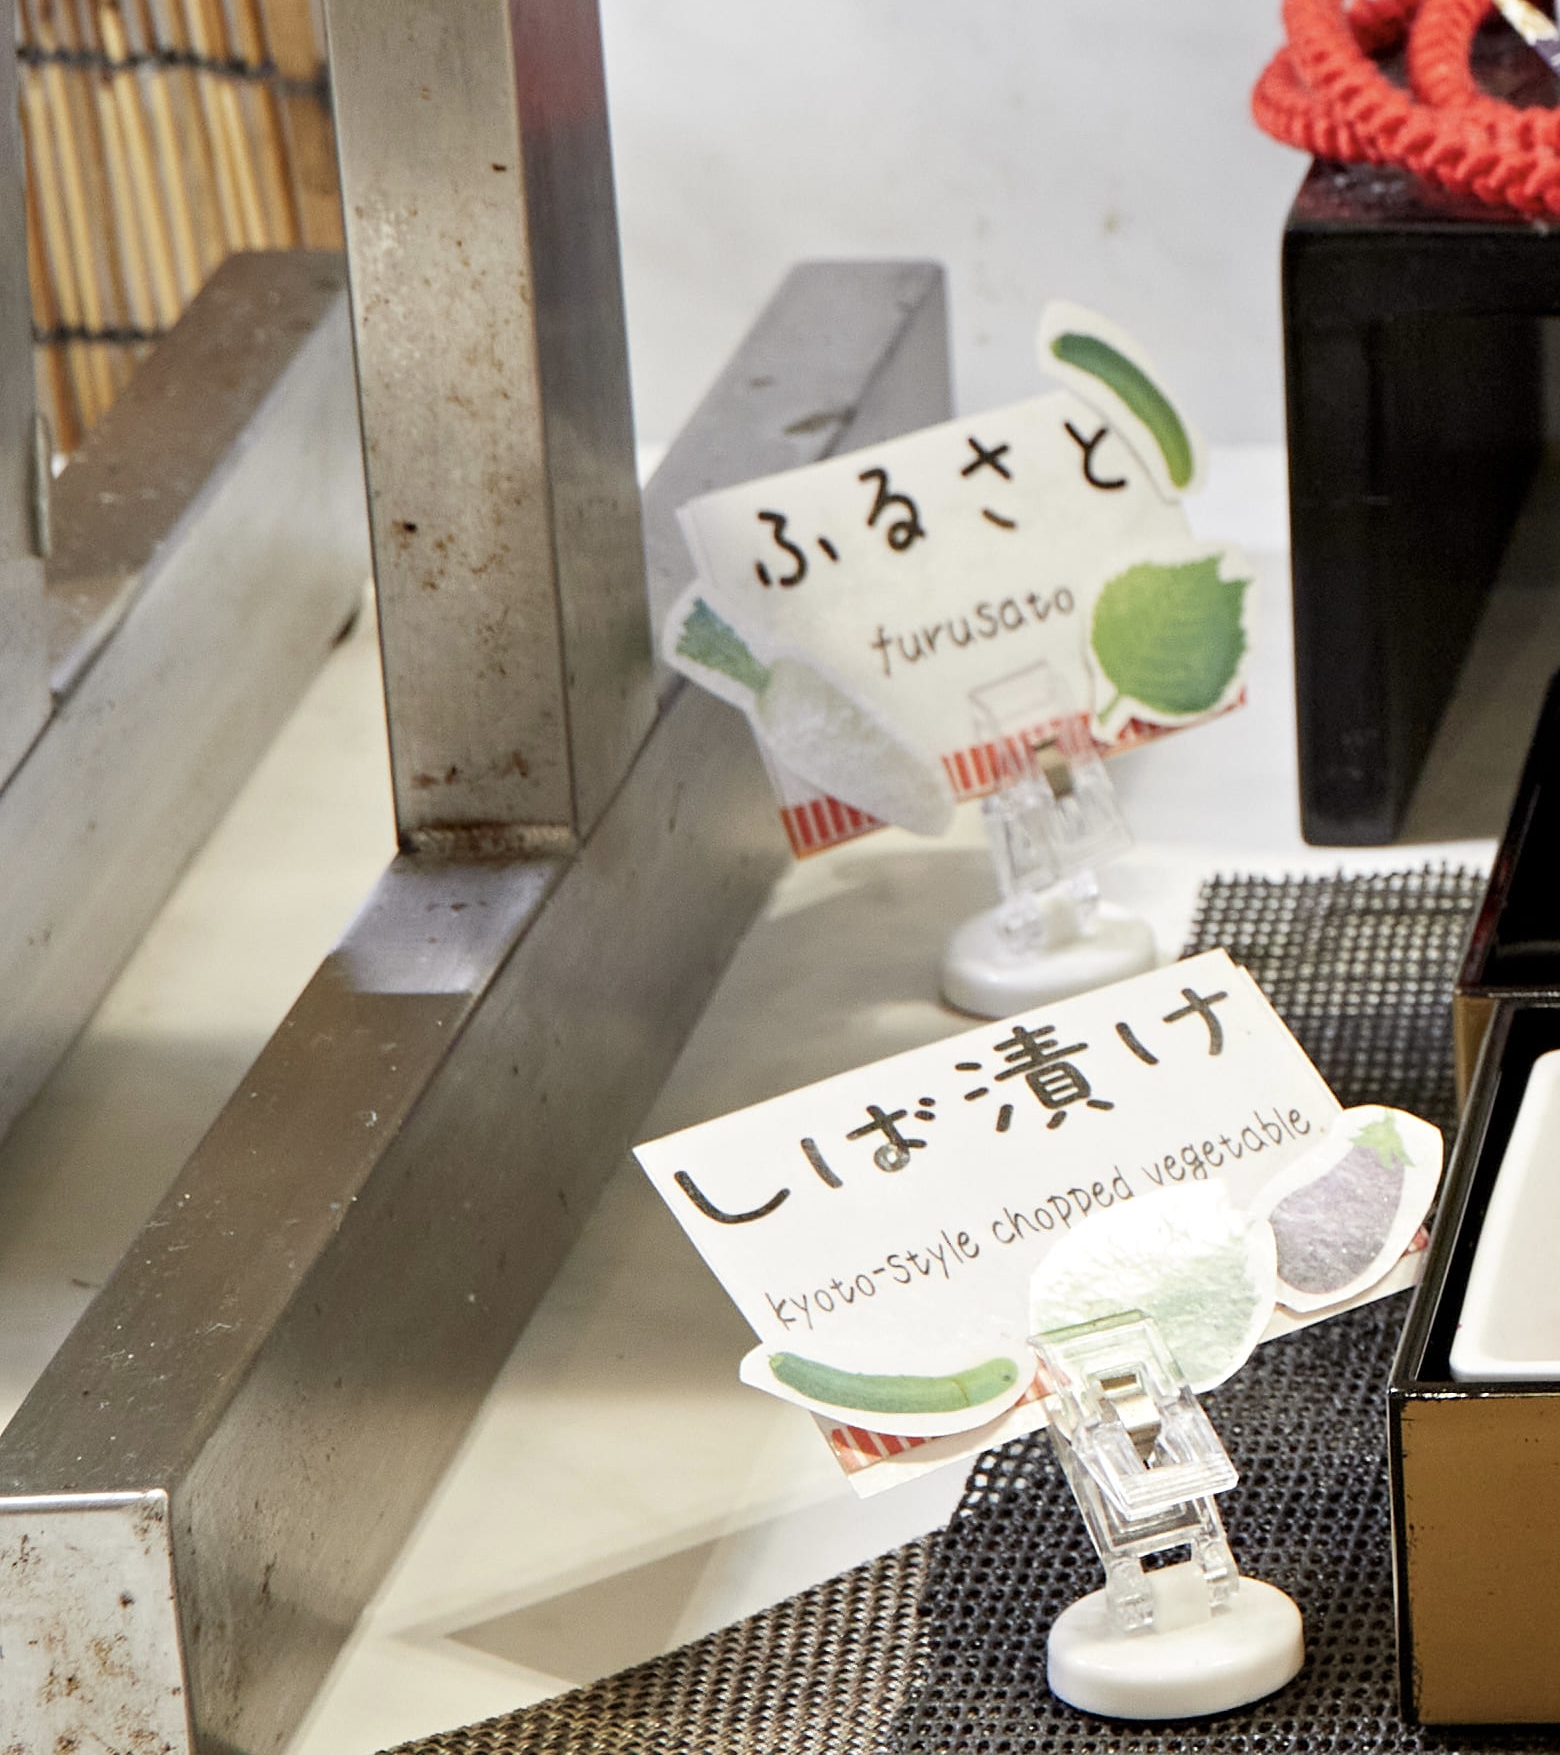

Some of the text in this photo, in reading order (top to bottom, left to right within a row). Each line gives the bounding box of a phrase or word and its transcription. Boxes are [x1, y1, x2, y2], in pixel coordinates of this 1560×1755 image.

[755, 420, 1127, 588] ふるさと
[672, 987, 1230, 1226] しば漬け
[992, 1165, 1133, 1244] chopped
[1142, 1107, 1311, 1186] vegetable
